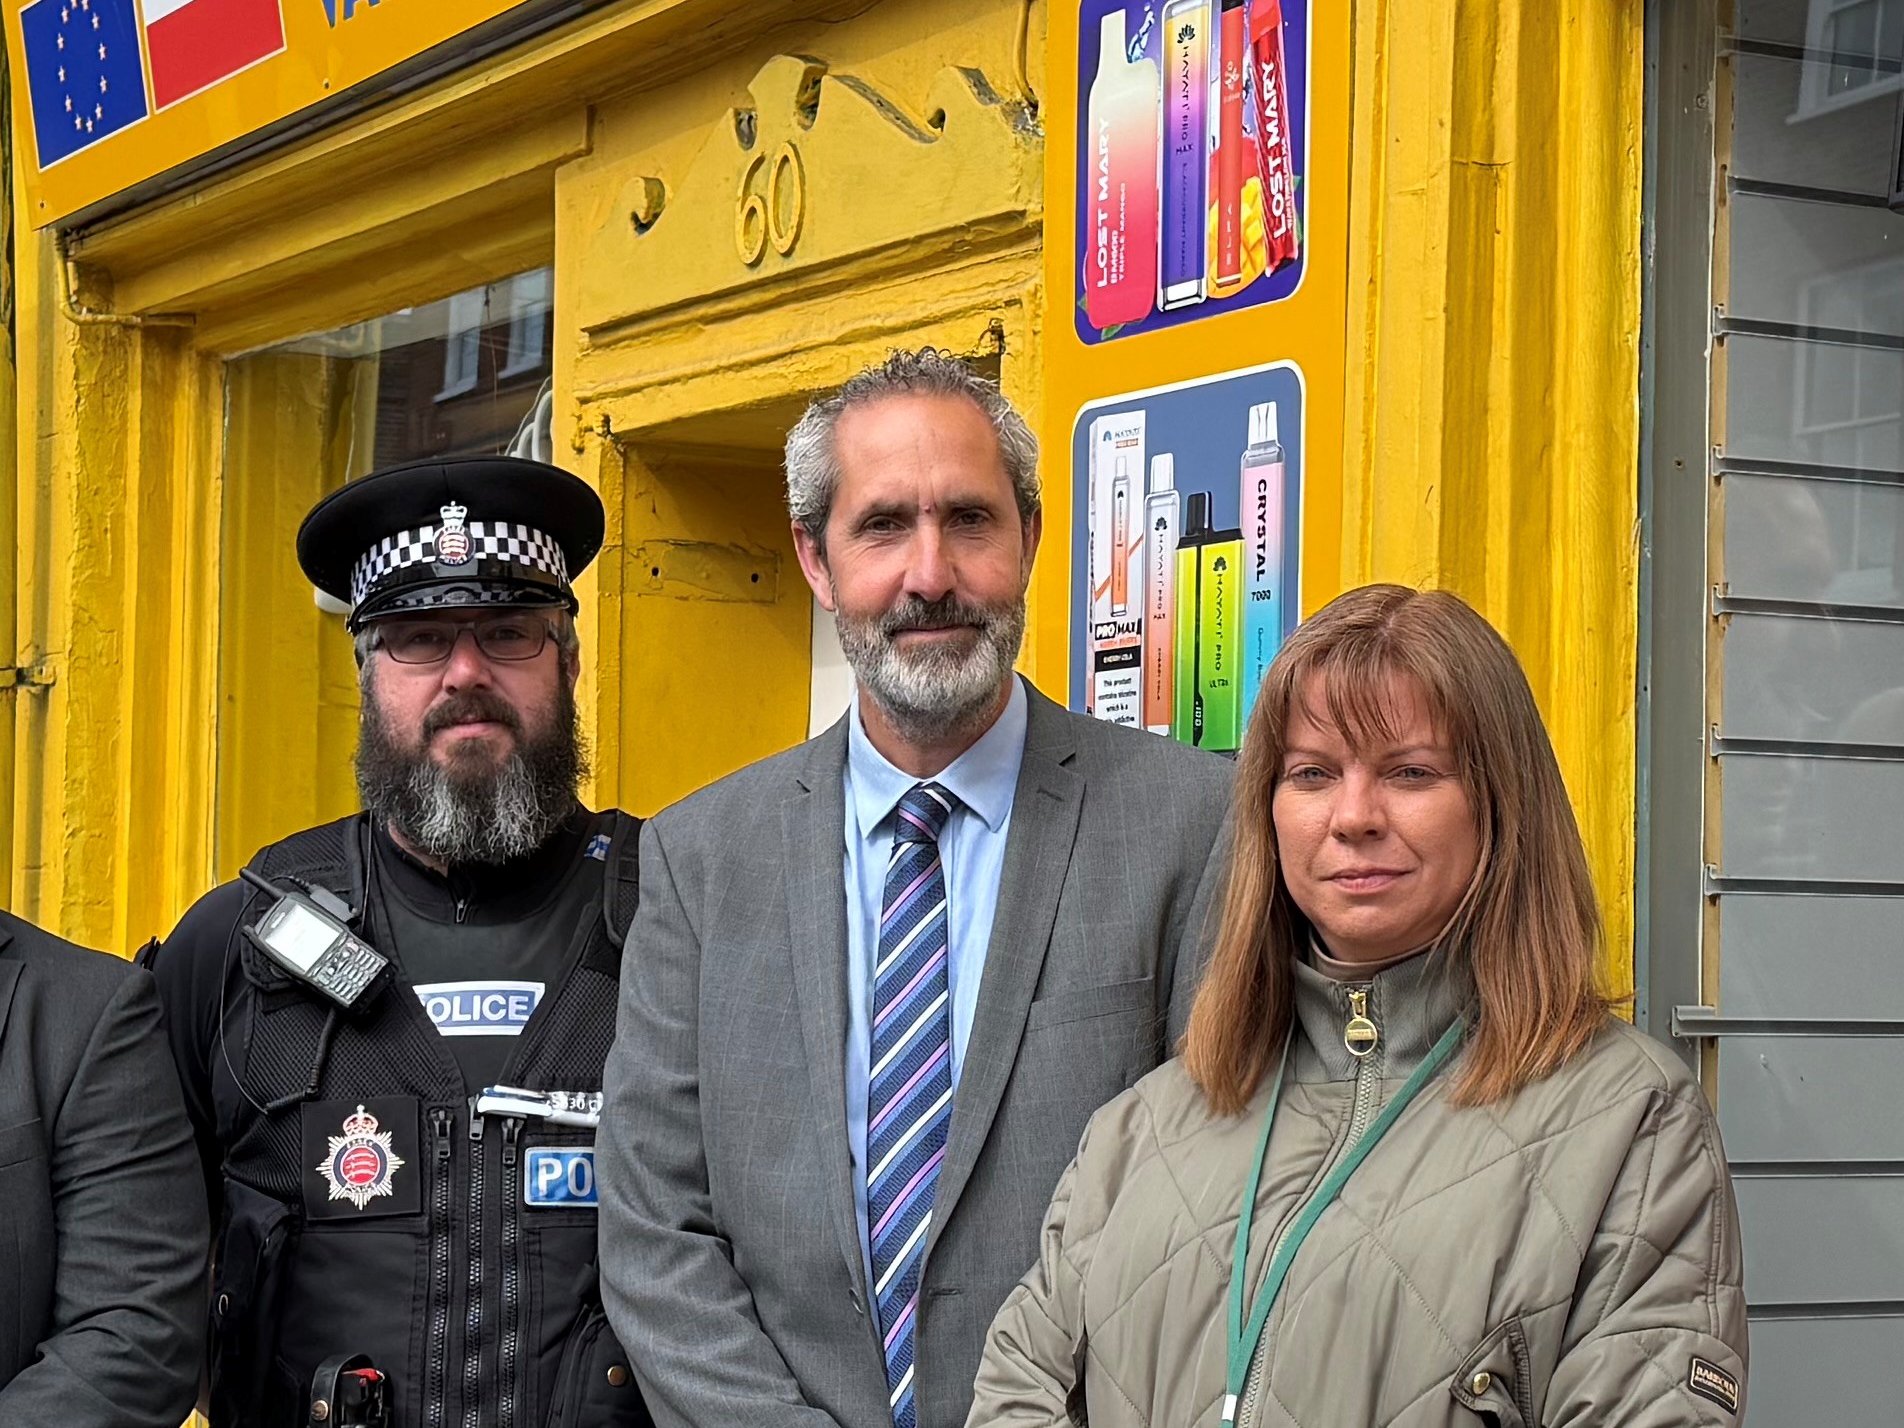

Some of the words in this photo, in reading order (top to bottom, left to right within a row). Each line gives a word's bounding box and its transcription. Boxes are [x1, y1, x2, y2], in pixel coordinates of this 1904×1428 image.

[1261, 62, 1280, 149] MARY
[1098, 119, 1109, 202] MARY
[1268, 155, 1287, 240] LOST
[734, 141, 804, 266] 60
[1097, 208, 1108, 288] LOST
[1255, 478, 1267, 583] CRYSTAL
[1096, 623, 1116, 640] PRO
[422, 995, 532, 1023] OLICE
[538, 1157, 593, 1198] PO
